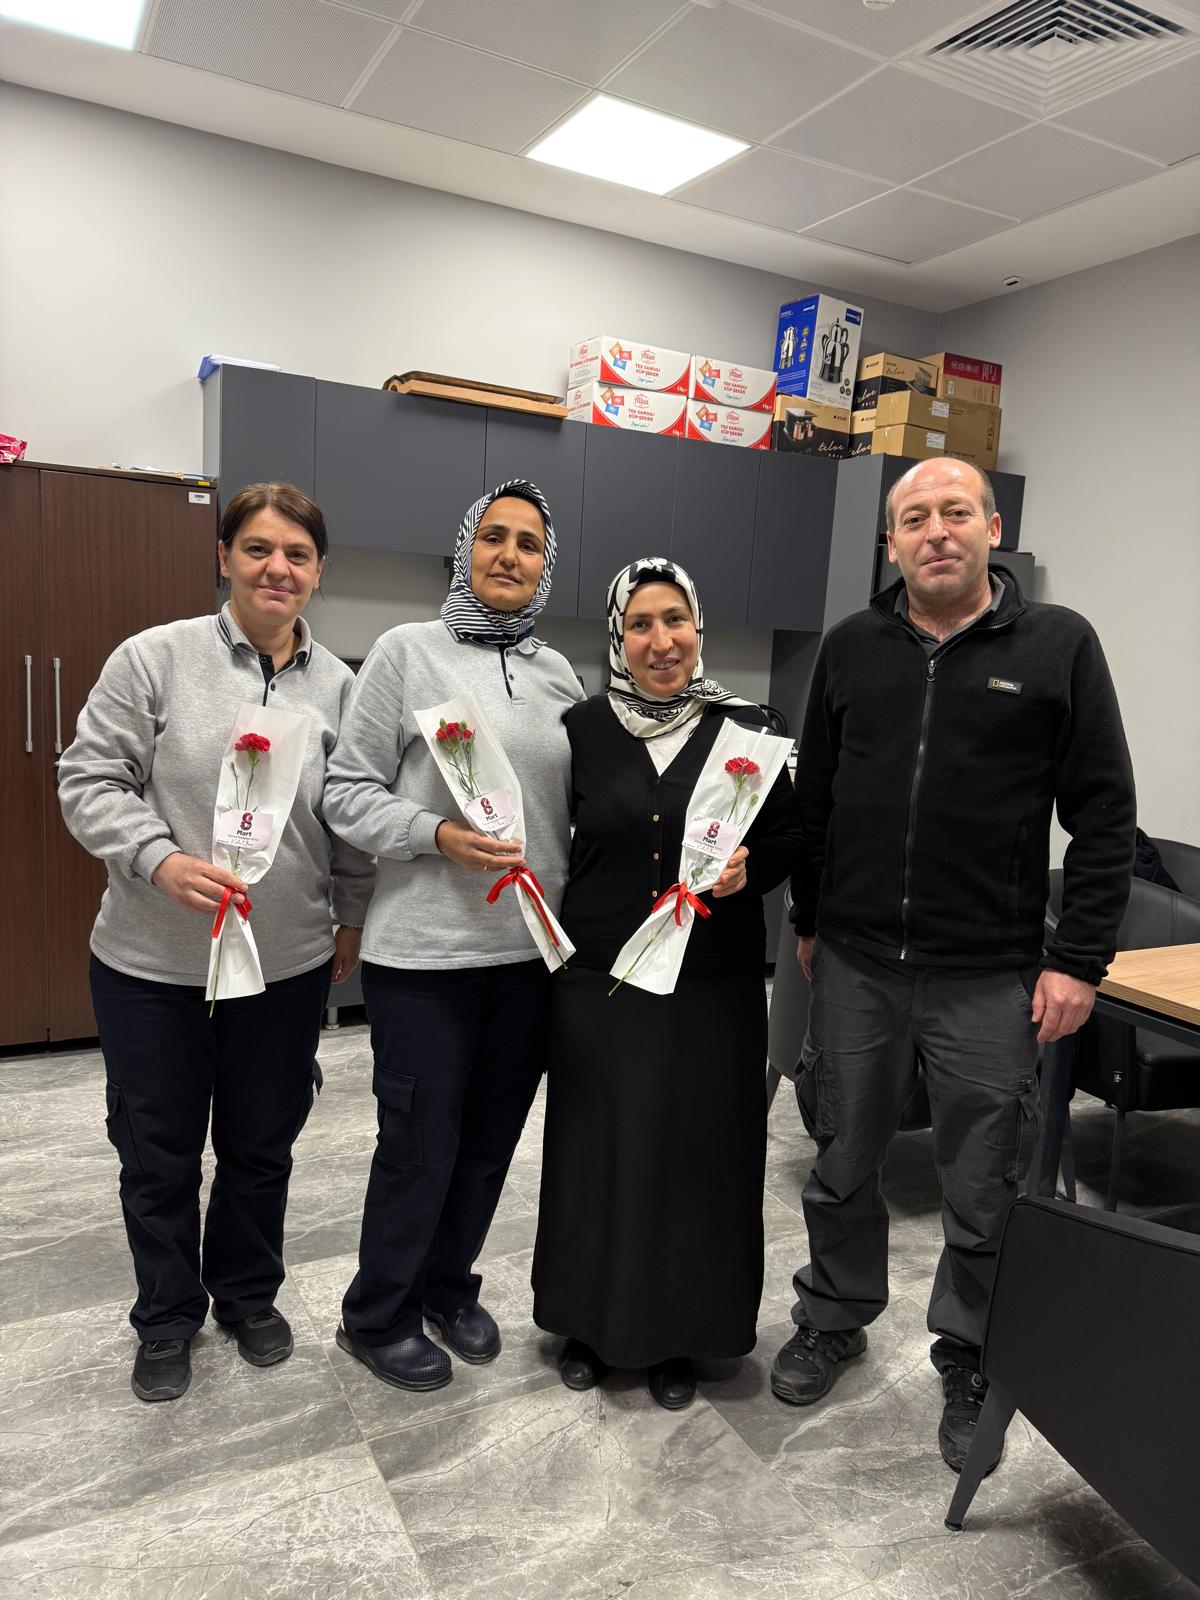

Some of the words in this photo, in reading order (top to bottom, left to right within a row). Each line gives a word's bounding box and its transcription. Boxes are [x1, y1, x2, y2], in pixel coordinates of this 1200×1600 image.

[818, 440, 845, 452] telve
[480, 797, 494, 816] 8
[240, 812, 254, 831] 8
[486, 813, 498, 821] Mart
[707, 820, 720, 838] 8
[702, 836, 717, 845] Mart
